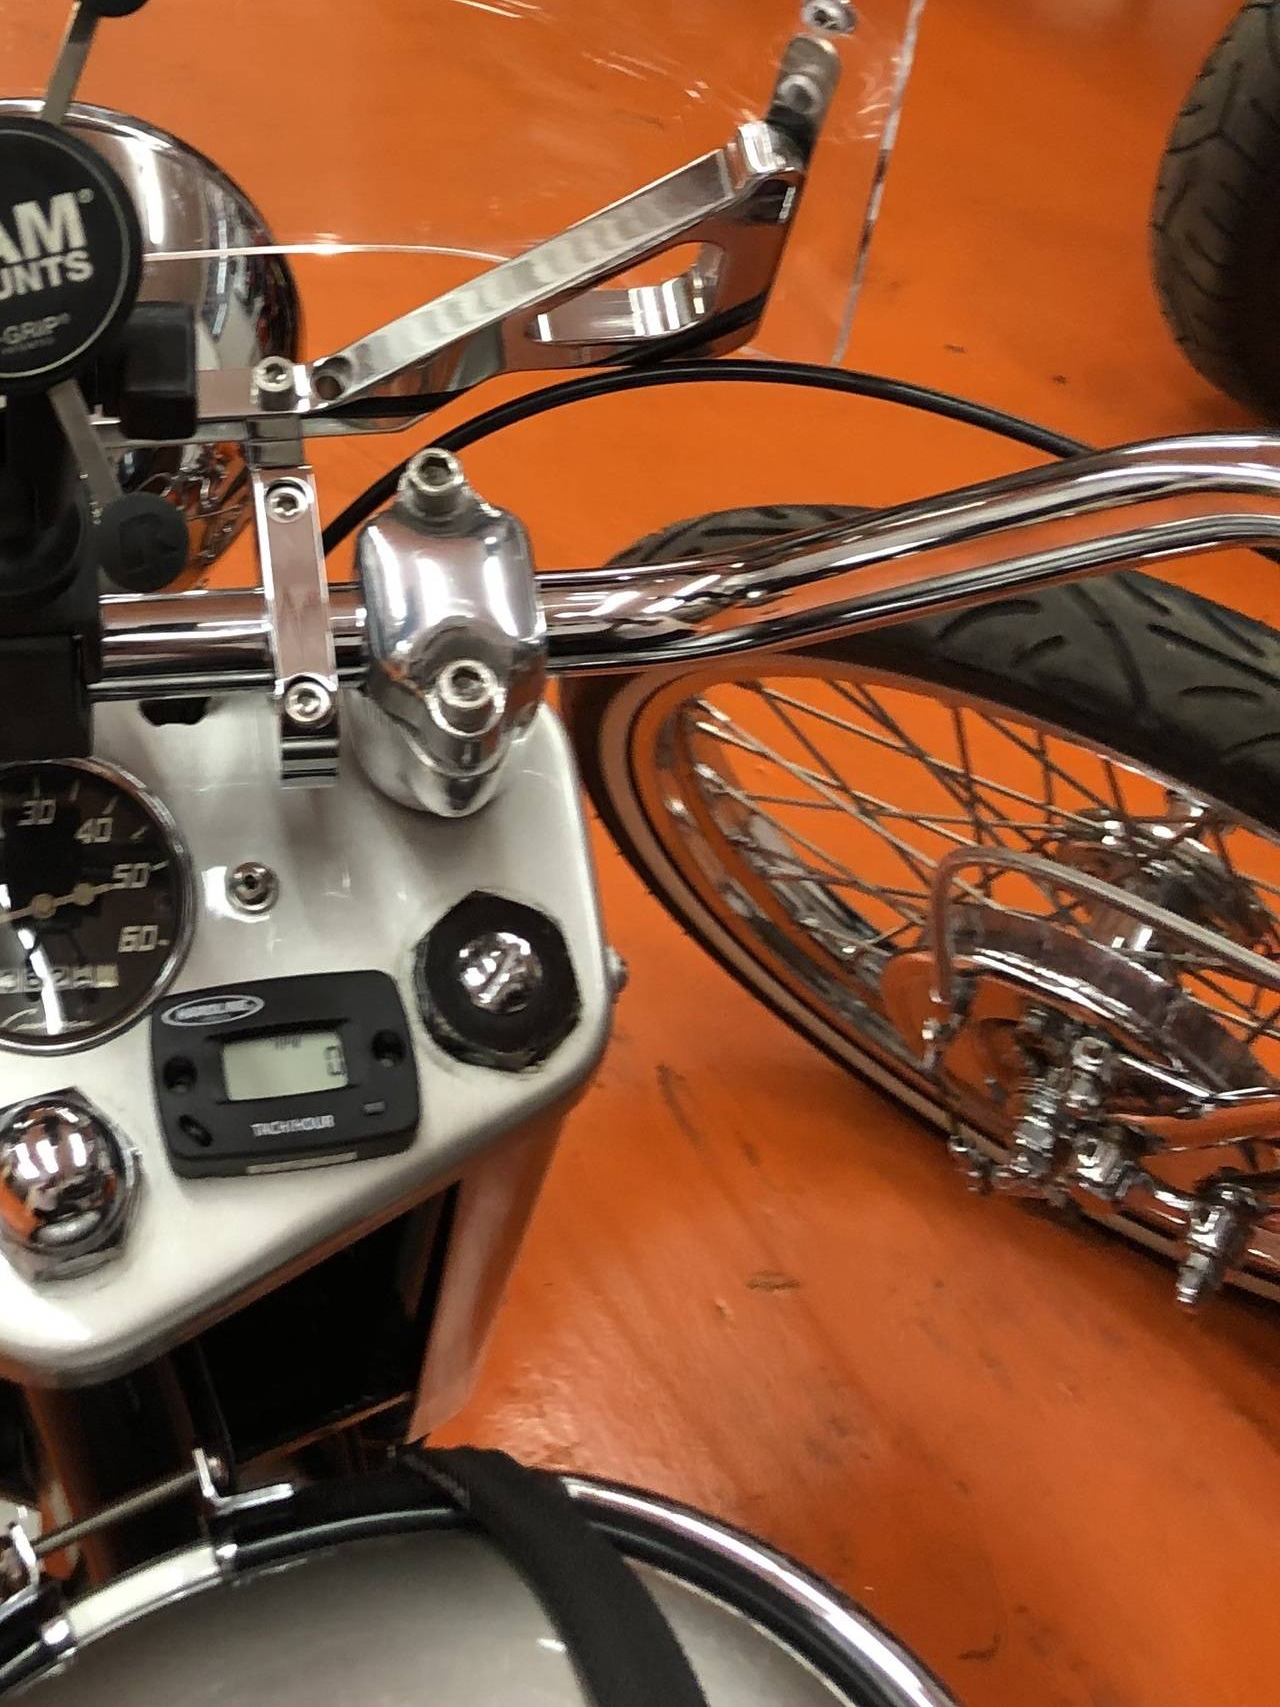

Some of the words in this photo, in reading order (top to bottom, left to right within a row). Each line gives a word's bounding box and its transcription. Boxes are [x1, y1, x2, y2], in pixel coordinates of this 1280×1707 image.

[17, 798, 56, 826] 30
[74, 817, 113, 844] 40
[112, 862, 152, 889] 50
[117, 924, 159, 953] 60
